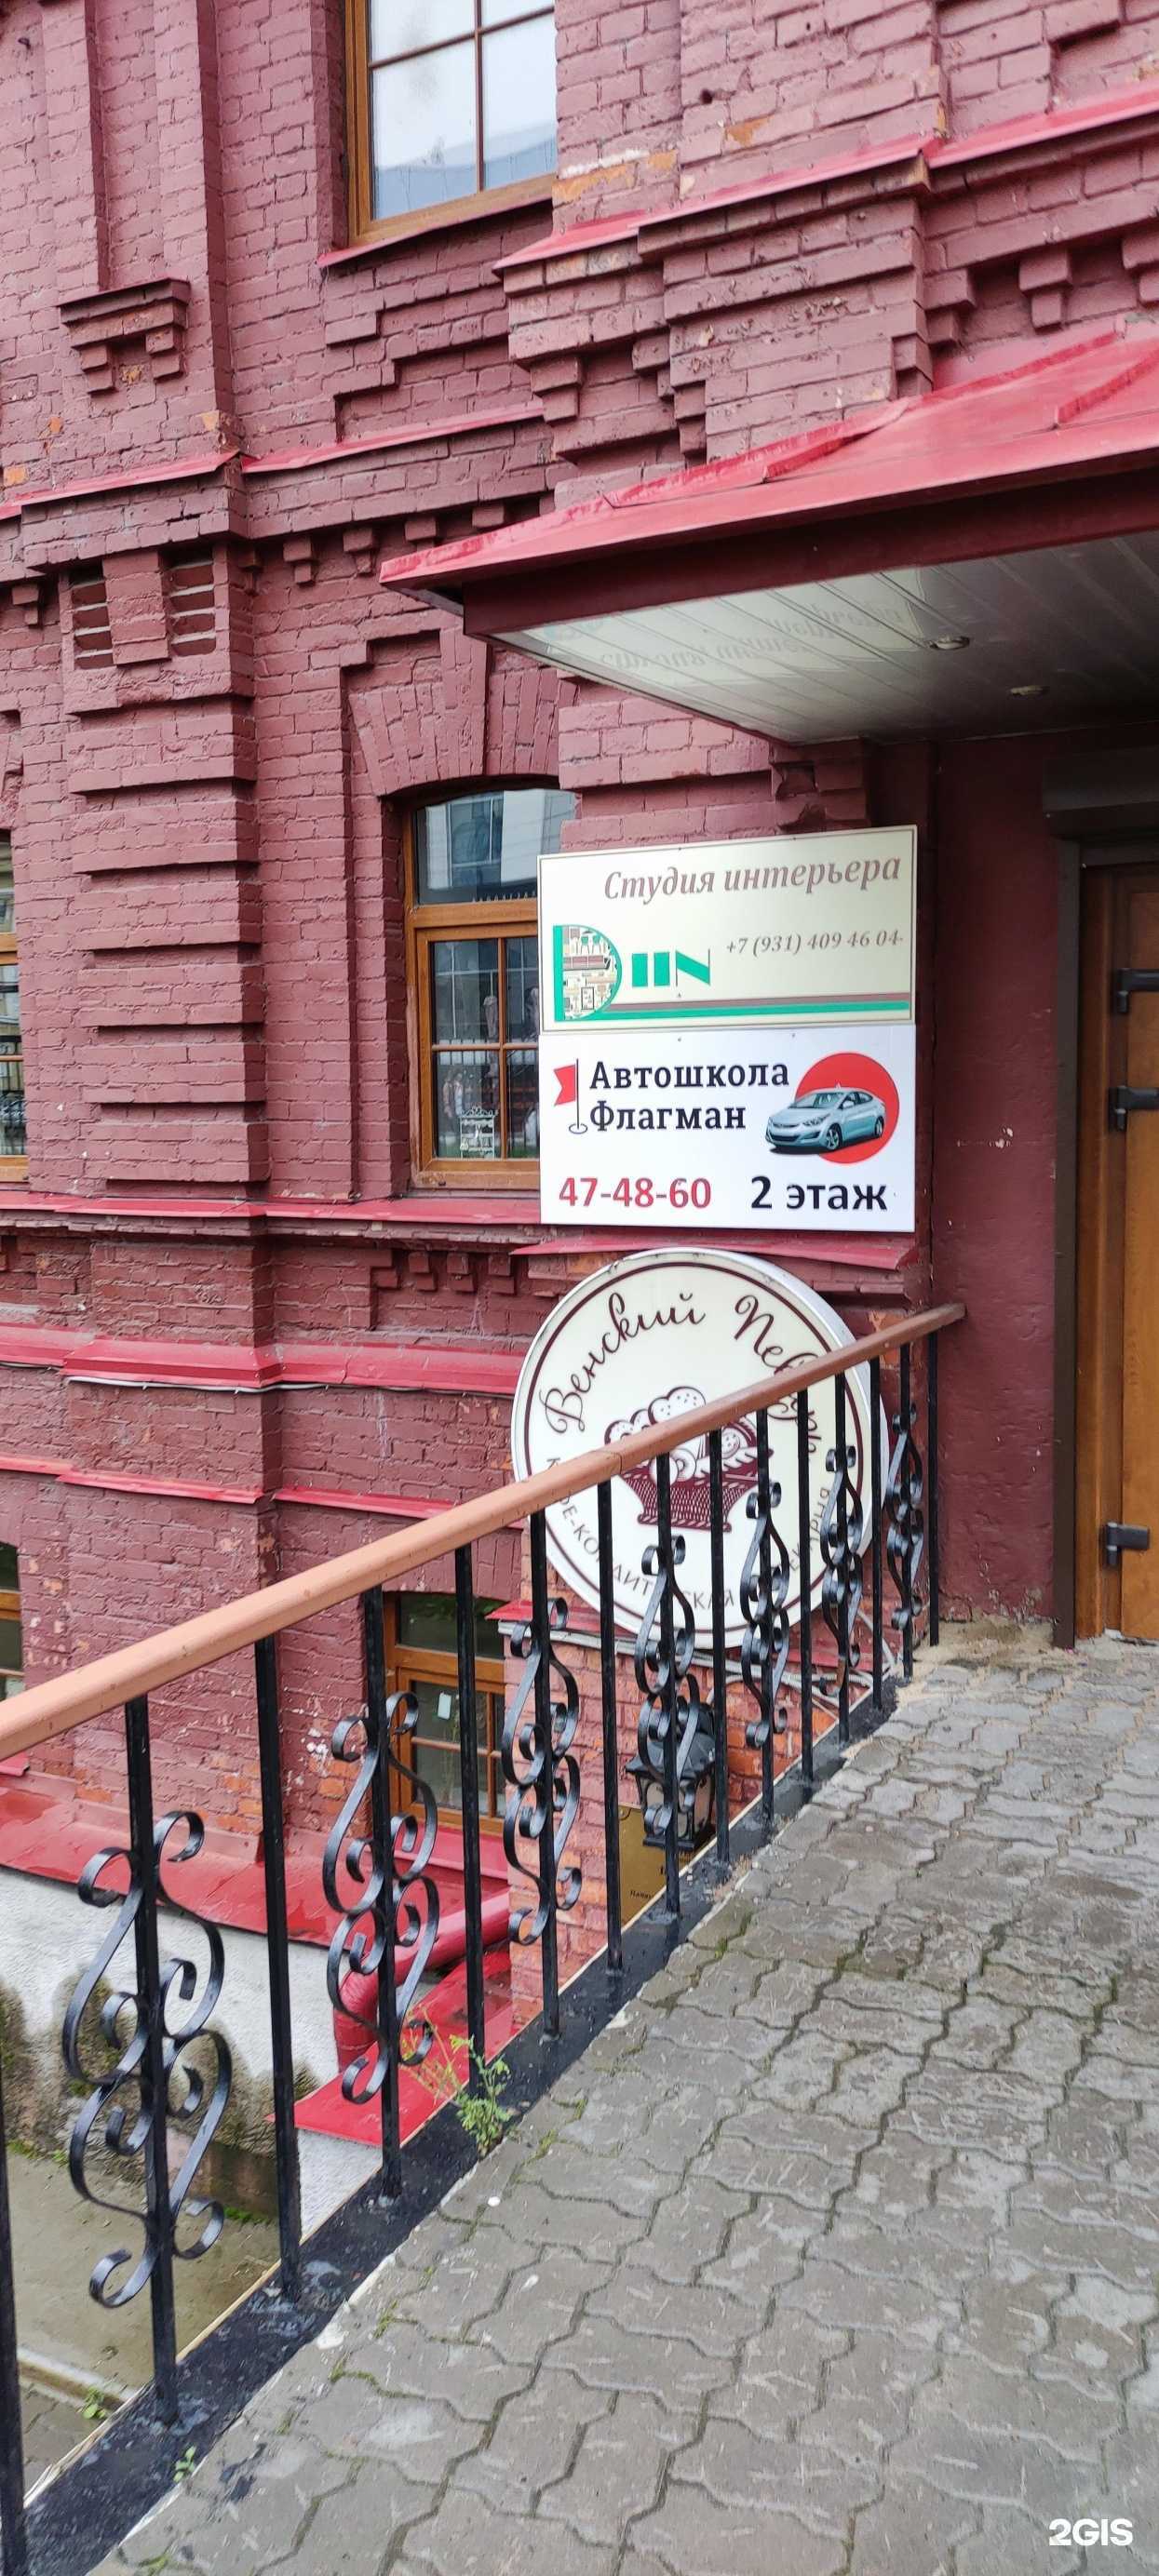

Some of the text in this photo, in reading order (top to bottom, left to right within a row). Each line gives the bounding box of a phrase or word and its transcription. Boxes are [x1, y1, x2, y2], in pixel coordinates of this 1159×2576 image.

[604, 855, 902, 906] Студия интерьера
[726, 937, 748, 954] +7
[752, 933, 802, 958] (931)
[807, 932, 842, 950] 409
[846, 931, 870, 948] 46
[589, 1061, 789, 1090] Автошкола
[589, 1100, 747, 1133] Флагман
[559, 1176, 712, 1210] 47-48-60
[750, 1175, 888, 1212] 2 этаж
[539, 1292, 707, 1434] Венский
